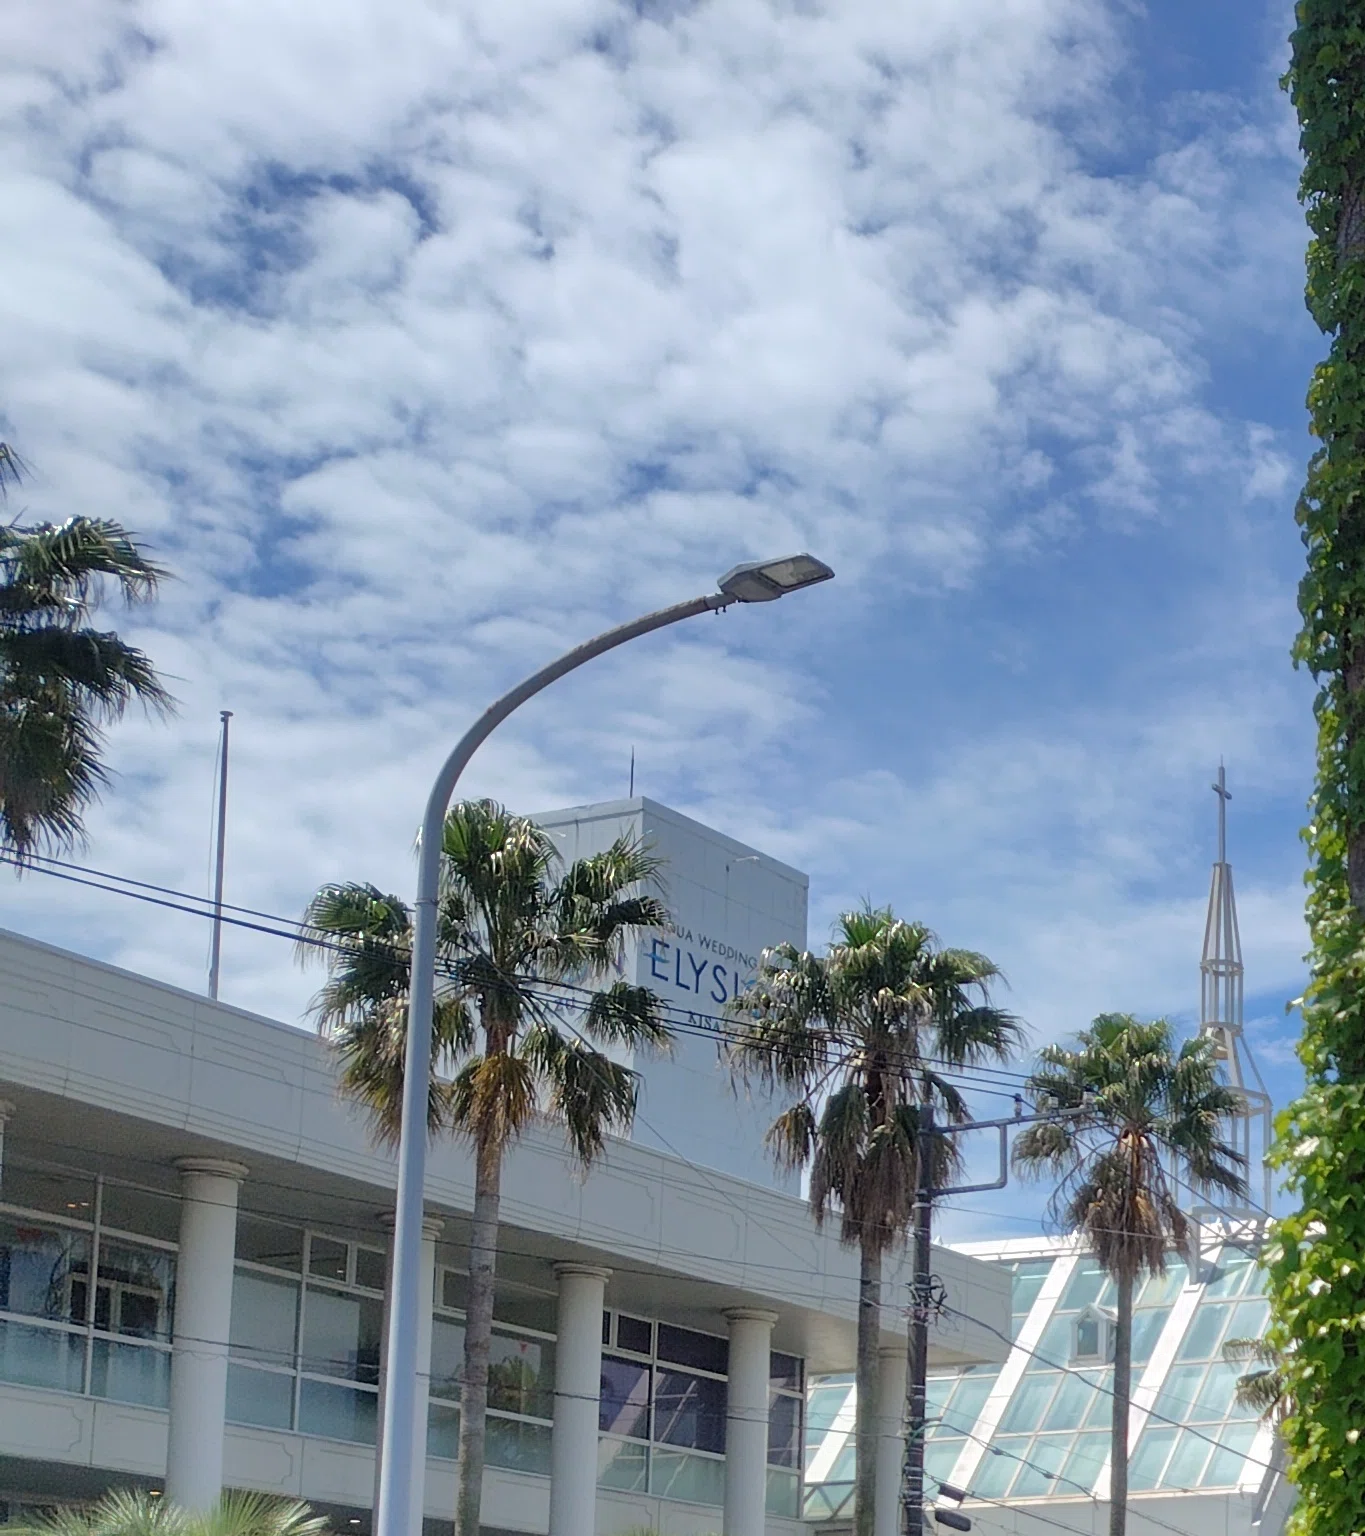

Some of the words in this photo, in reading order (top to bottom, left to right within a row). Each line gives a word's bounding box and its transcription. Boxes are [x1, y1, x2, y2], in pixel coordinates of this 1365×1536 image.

[698, 933, 757, 969] WEDDING
[651, 938, 739, 1004] ELYSI
[688, 1011, 720, 1031] KISA
